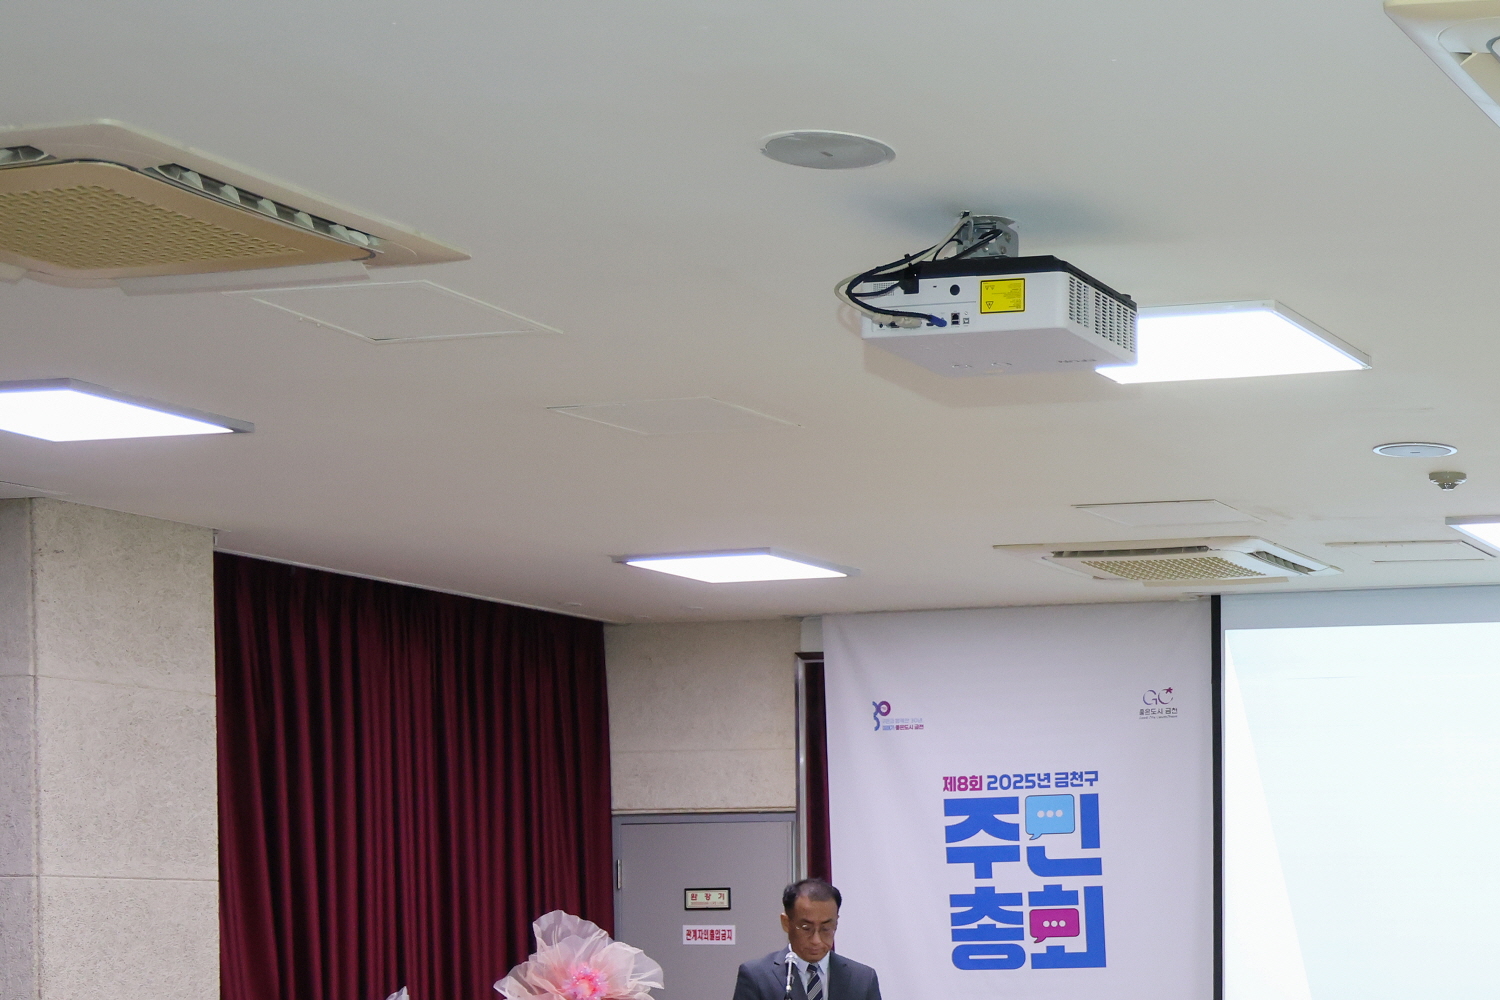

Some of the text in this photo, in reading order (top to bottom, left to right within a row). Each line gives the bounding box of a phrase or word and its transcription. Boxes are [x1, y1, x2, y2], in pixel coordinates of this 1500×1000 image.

[943, 770, 1098, 792] 제8회 2025년 금천구
[943, 793, 1103, 880] 주민
[685, 929, 733, 941] 관계자외출입금지
[949, 884, 1107, 971] 총회
